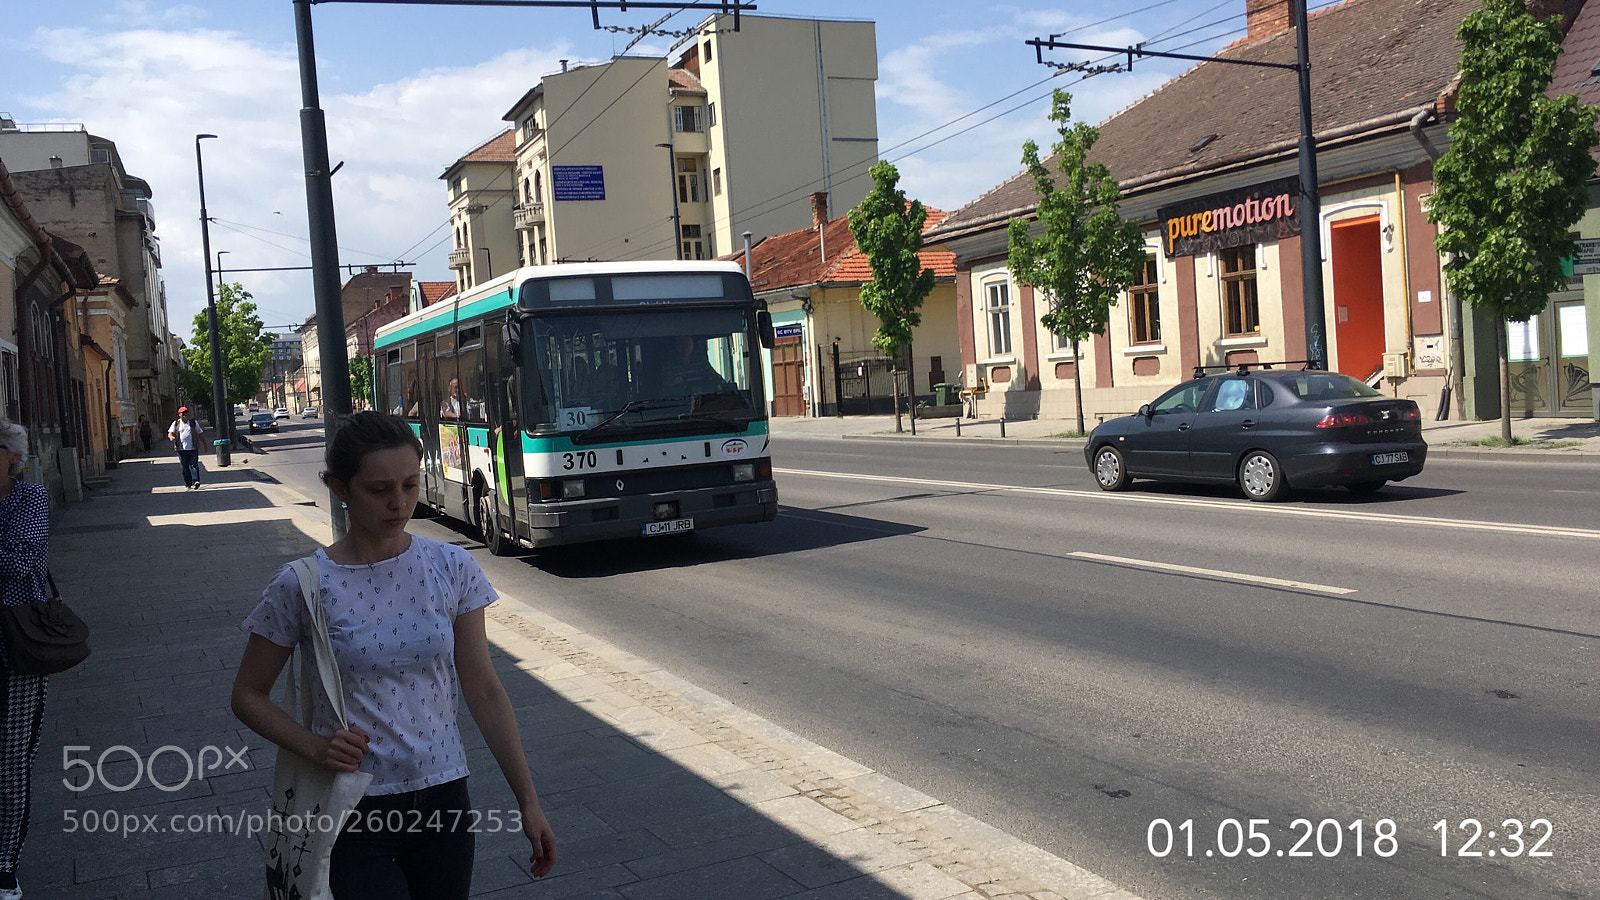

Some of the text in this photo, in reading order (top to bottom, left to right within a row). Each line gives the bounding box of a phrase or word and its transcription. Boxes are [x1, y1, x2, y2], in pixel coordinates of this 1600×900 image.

[1167, 192, 1294, 253] puremotion
[566, 411, 586, 426] 30
[562, 450, 597, 470] 370
[649, 522, 661, 533] CJ
[673, 519, 691, 531] JRB
